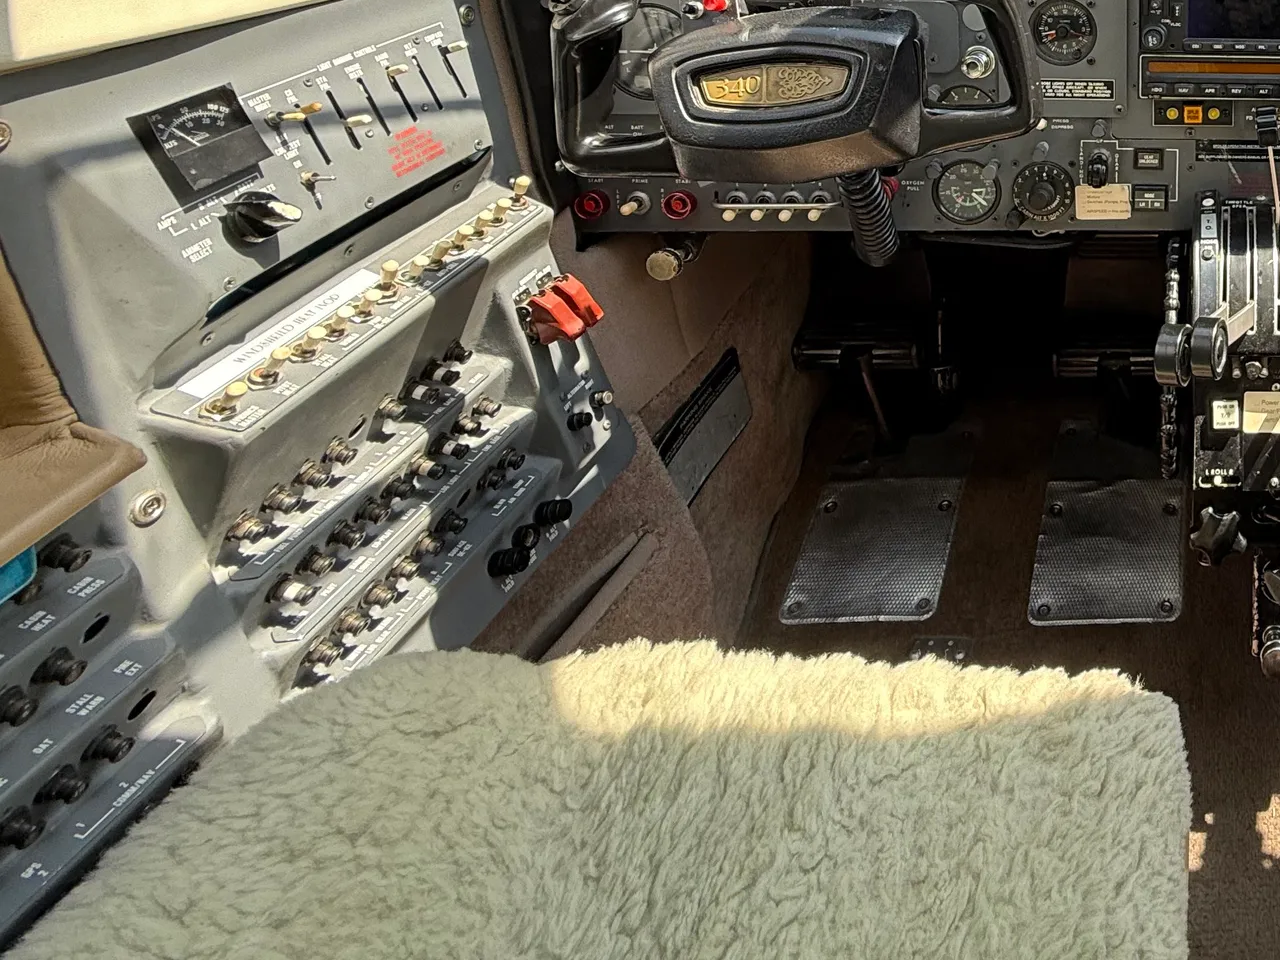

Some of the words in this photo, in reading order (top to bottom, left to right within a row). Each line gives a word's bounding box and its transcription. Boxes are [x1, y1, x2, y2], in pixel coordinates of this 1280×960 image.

[714, 75, 761, 98] 340
[157, 217, 177, 230] AMPS
[182, 239, 213, 258] AMMETER
[190, 248, 213, 263] SELECT
[67, 576, 94, 595] CABIN
[77, 579, 106, 598] PRESS
[18, 610, 46, 630] CABIN
[31, 614, 56, 632] HEAT
[113, 659, 134, 674] FIRE
[124, 663, 144, 677] EXT
[65, 693, 94, 715] STALL
[77, 696, 105, 716] WARN
[32, 738, 54, 755] OAT
[113, 769, 156, 808] COMM/NAV
[20, 863, 42, 880] GPS
